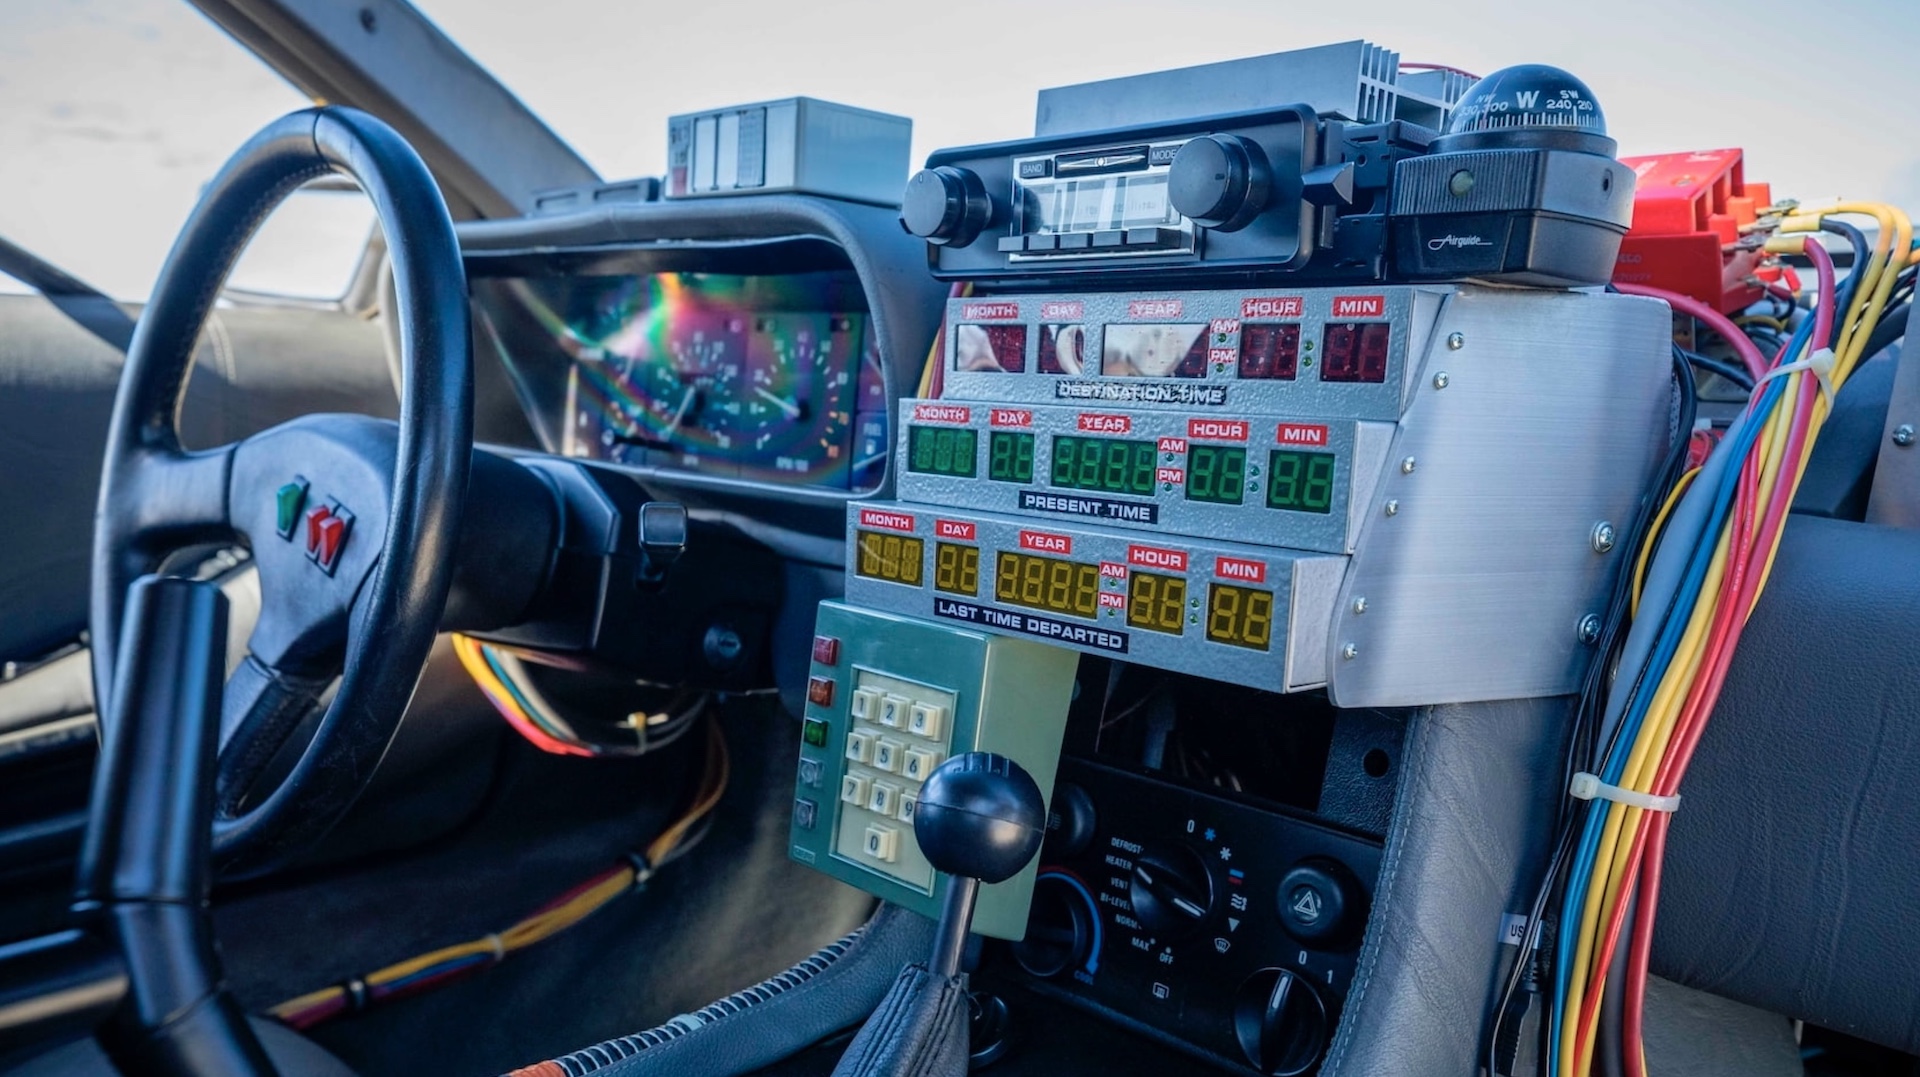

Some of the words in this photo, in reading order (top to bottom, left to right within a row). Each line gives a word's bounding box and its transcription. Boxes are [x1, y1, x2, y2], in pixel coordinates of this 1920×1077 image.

[1516, 90, 1540, 109] W
[1560, 90, 1579, 99] SW
[1546, 99, 1572, 110] 240
[1577, 100, 1593, 111] 210
[1152, 149, 1176, 161] MODE
[1022, 163, 1042, 175] BAND
[1428, 234, 1493, 250] Airguide
[966, 304, 1015, 318] MONTH
[1049, 305, 1076, 317] DAY
[1134, 302, 1177, 316] YEAR
[1246, 300, 1298, 315] HOUR
[1340, 299, 1377, 313] MIN
[1212, 320, 1238, 332] AM
[1210, 350, 1235, 362] PM
[1059, 383, 1171, 400] DESTINATION
[1179, 387, 1223, 402] TIME
[920, 408, 965, 421] MONTH
[998, 411, 1026, 424] DAY
[1085, 416, 1126, 430] YEAR
[1193, 423, 1243, 438] HOUR
[1284, 427, 1321, 442] MIN
[1160, 440, 1184, 452] AM
[1158, 470, 1182, 482] PM
[1025, 494, 1102, 516] PRESENT
[1108, 503, 1150, 521] TIME
[864, 513, 910, 529] MONTH
[943, 523, 970, 537] DAY
[1025, 535, 1066, 550] YEAR
[1133, 549, 1182, 568] HOUR
[1101, 564, 1124, 578] AM
[1222, 563, 1259, 578] MIN
[1100, 595, 1122, 608] PM
[939, 602, 977, 620] LAST
[983, 609, 1021, 628] TIME
[1027, 617, 1122, 648] DEPARTED
[858, 697, 865, 712] 1
[886, 704, 894, 720] 2
[915, 713, 923, 729] 3
[852, 739, 860, 752] 4
[880, 748, 888, 764] 5
[909, 758, 918, 773] 6
[847, 781, 856, 796] 7
[876, 790, 884, 806] 8
[905, 799, 913, 815] 9
[1187, 819, 1195, 833] 0
[870, 834, 878, 851] 0
[1111, 837, 1141, 854] DEFROST
[1105, 854, 1132, 871] HEATER
[1111, 877, 1128, 890] VENT
[1100, 892, 1131, 911] BI-LEVEL
[1131, 937, 1150, 952] MAX
[1159, 952, 1174, 965] OFF
[1298, 950, 1307, 965] 0
[1326, 969, 1334, 984] 1
